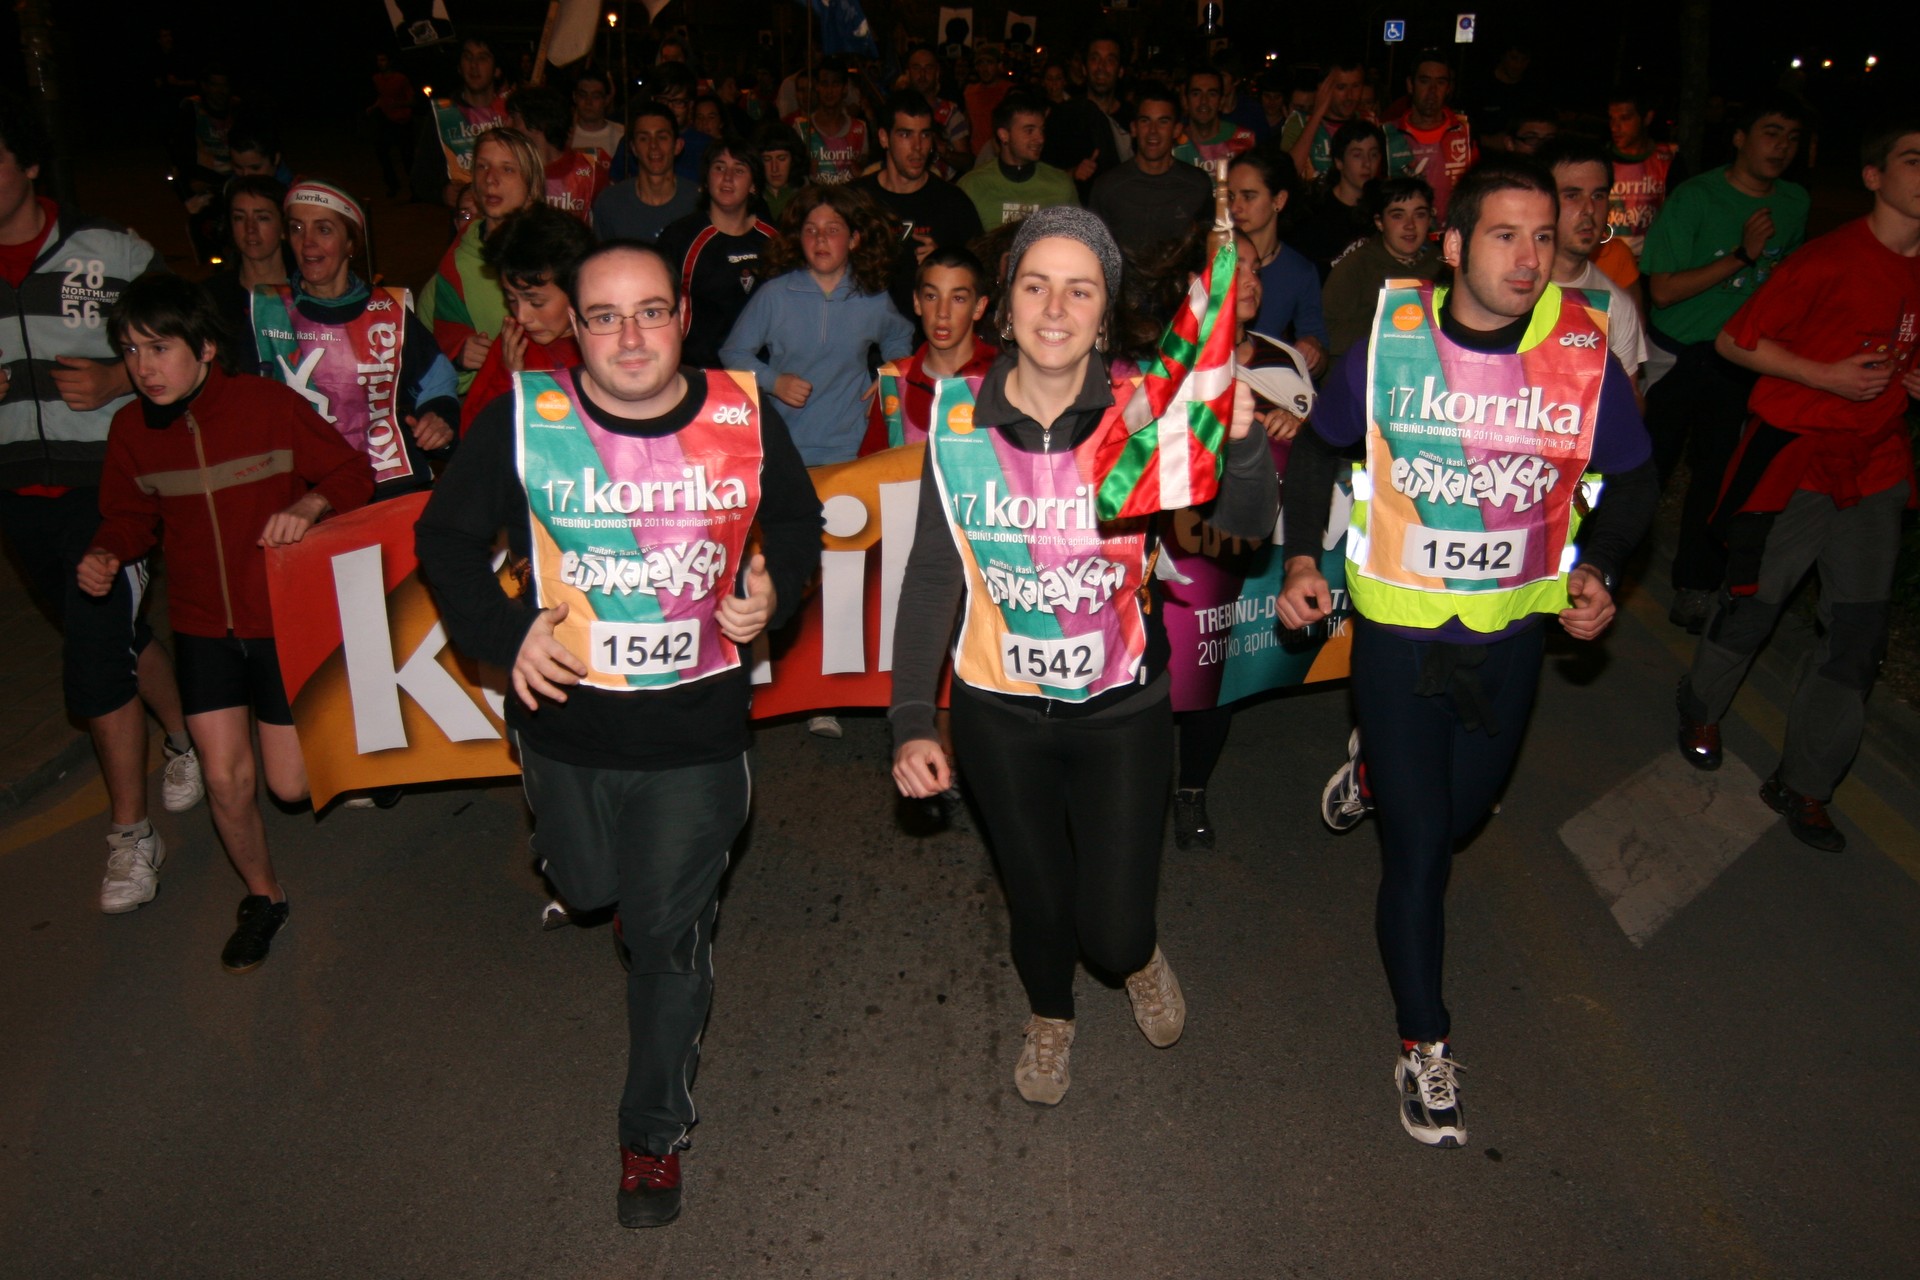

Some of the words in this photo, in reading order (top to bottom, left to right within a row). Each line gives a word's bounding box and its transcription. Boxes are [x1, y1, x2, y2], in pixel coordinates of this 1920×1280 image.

[296, 193, 329, 204] korrika
[62, 258, 105, 290] 28
[62, 299, 101, 329] 56
[366, 298, 394, 312] aek
[1559, 332, 1600, 350] aek
[357, 322, 403, 472] korrika
[1387, 386, 1415, 419] 17.
[1420, 376, 1581, 436] korrika
[713, 402, 752, 426] aek
[1389, 421, 1472, 439] TREBIÑU-DONOSTIA
[1473, 429, 1503, 443] 2011ko
[1504, 434, 1542, 446] apirilaren
[542, 479, 579, 513] 17.
[583, 465, 748, 514] korrika
[985, 481, 1099, 531] korri
[550, 516, 642, 529] TREBIÑU-DONOSTIA
[644, 517, 675, 528] 2011ko
[676, 517, 713, 529] apirilaren
[1037, 534, 1067, 546] 2011ko
[1422, 540, 1513, 572] 1542
[602, 632, 693, 668] 1542
[1007, 644, 1093, 680] 1542
[1197, 634, 1241, 666] 2011ko
